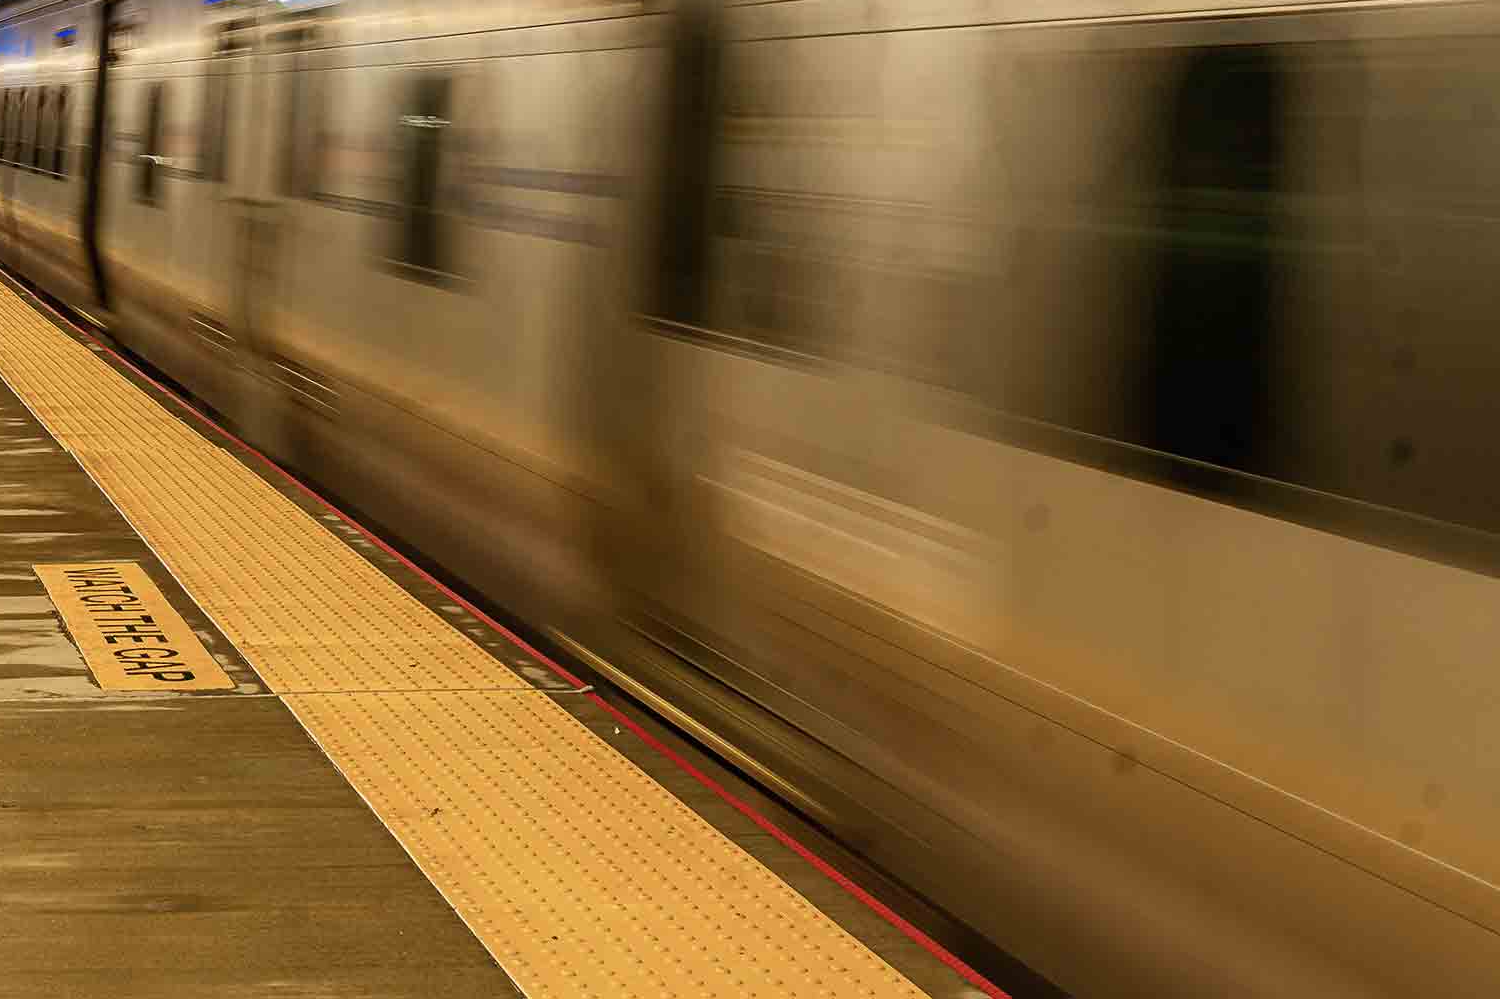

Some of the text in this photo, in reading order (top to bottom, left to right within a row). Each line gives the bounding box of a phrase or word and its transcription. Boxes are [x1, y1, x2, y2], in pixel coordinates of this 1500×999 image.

[64, 567, 196, 682] WATCH THE GAP
